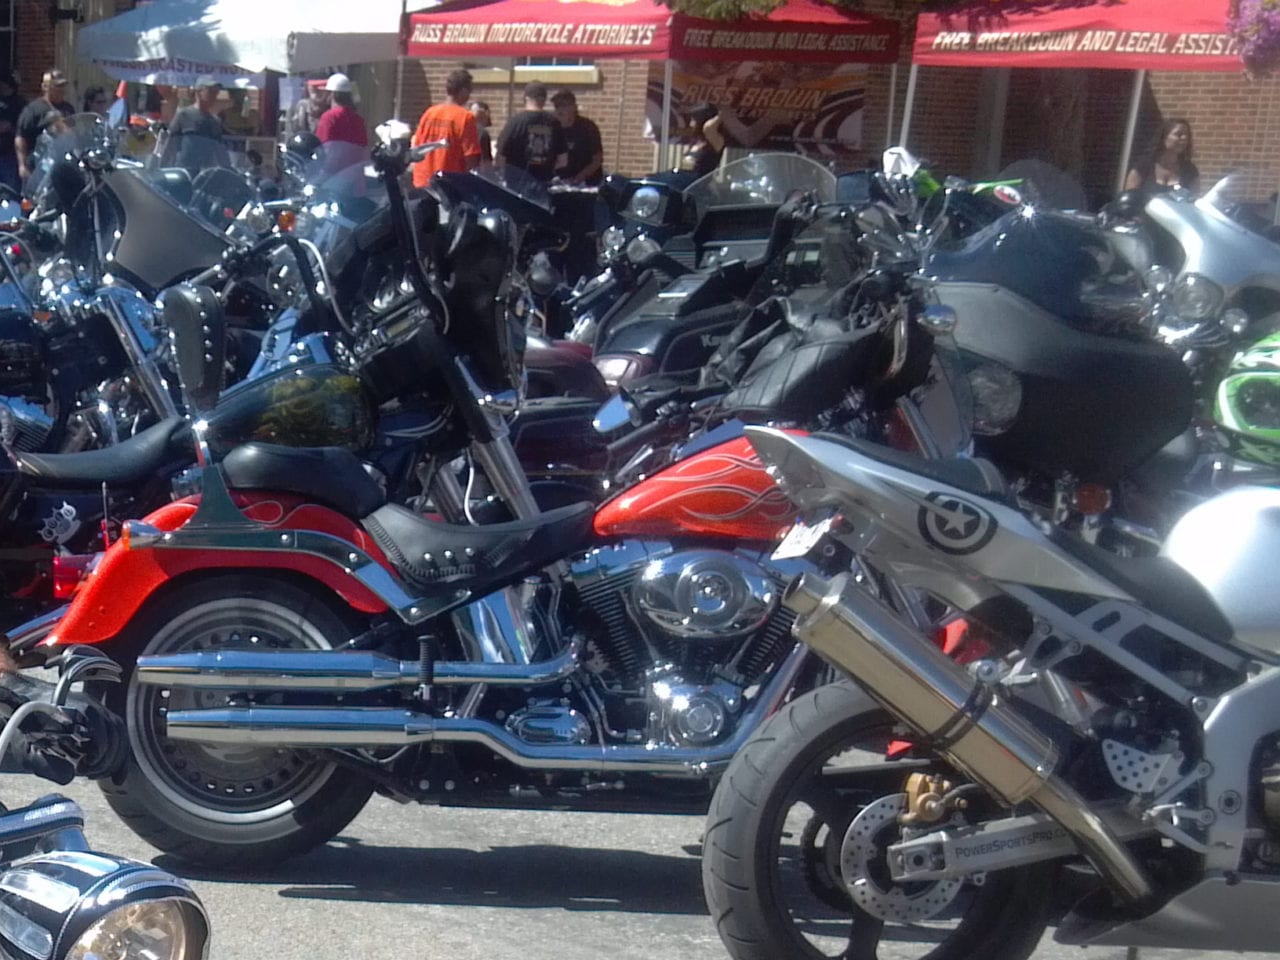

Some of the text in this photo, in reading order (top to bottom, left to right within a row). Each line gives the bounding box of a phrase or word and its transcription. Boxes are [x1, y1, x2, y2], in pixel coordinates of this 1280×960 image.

[411, 22, 657, 46] RUSS BROWN MOTORCYCLE ATTORNEYS
[683, 28, 890, 51] FREE BREAKDOWN AND LEGAL ASSISTANCE
[932, 31, 1239, 55] FREE BREAKDOWN AND LEGAL ASSIST
[682, 84, 826, 109] RUSS BROWN
